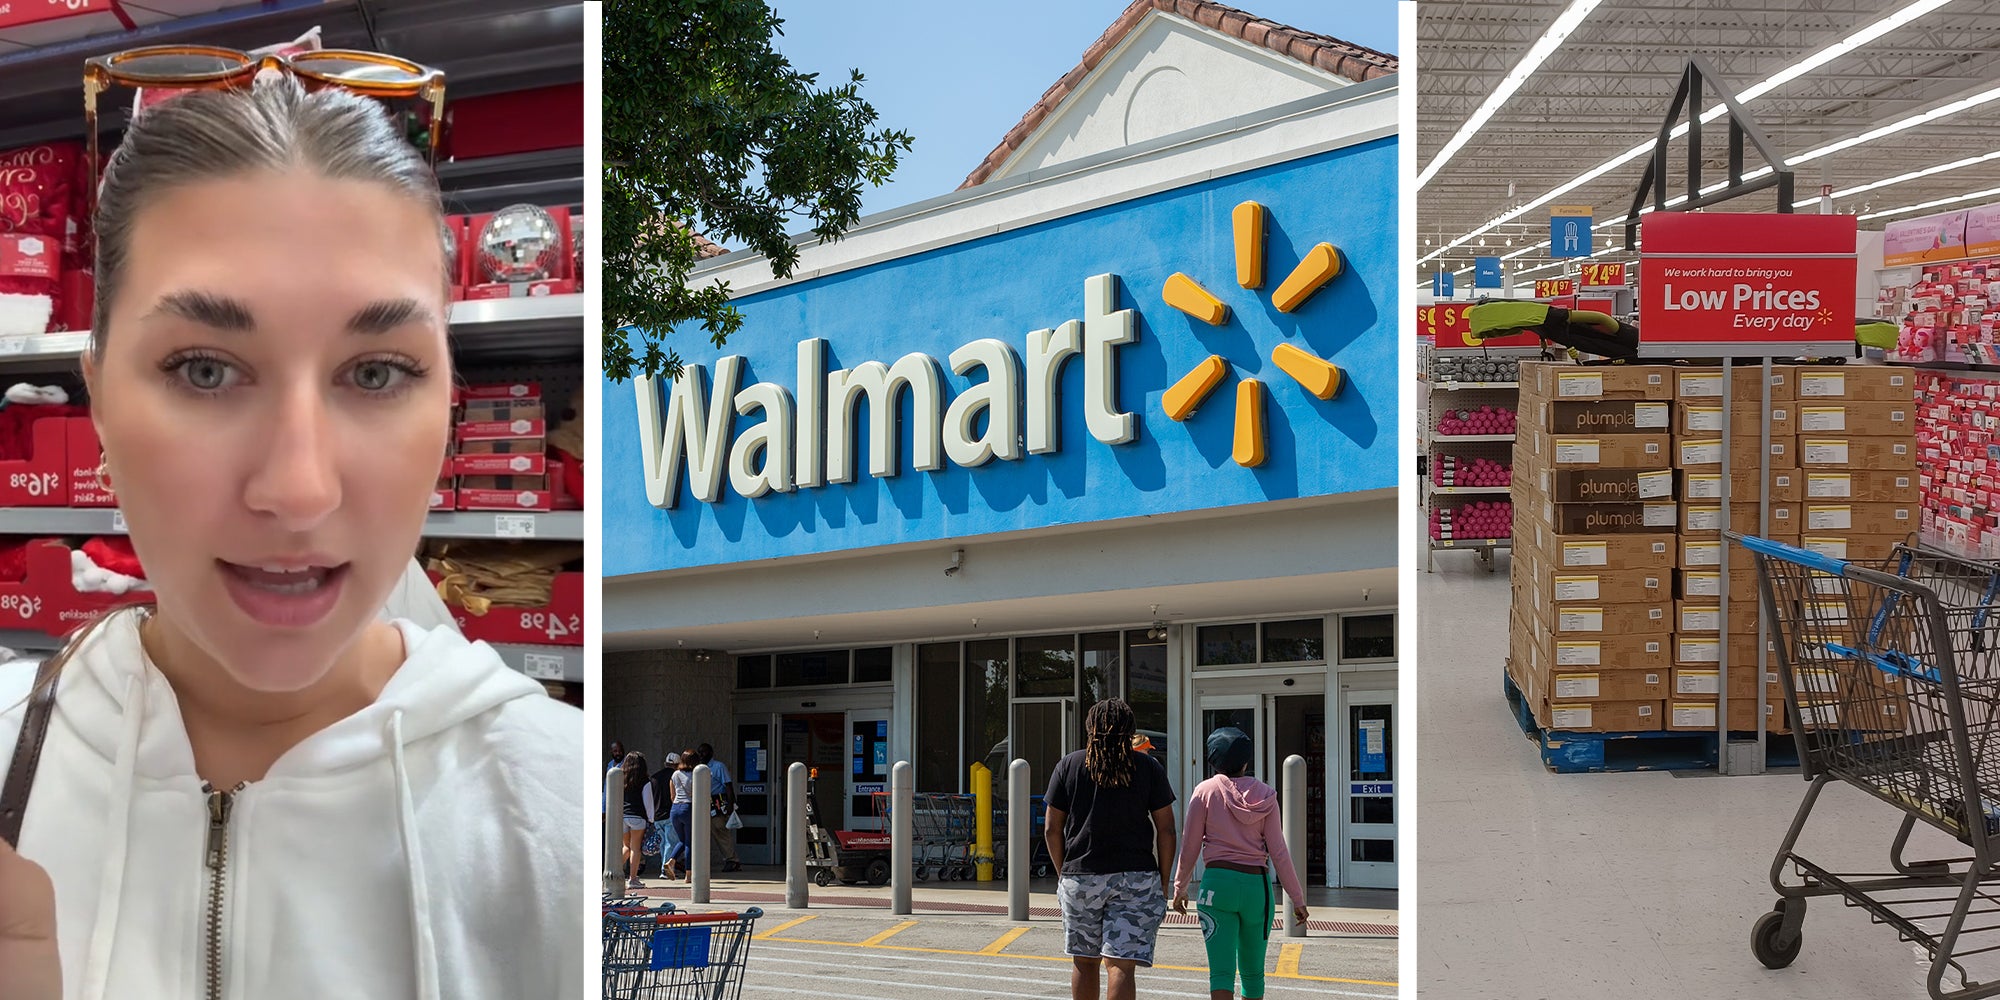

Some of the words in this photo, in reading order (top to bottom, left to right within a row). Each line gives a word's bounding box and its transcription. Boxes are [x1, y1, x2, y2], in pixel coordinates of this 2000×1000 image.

[1664, 268, 1680, 277] We
[1682, 268, 1706, 277] work
[1707, 268, 1732, 277] hard
[1733, 268, 1745, 277] to
[1746, 268, 1773, 278] bring
[1774, 269, 1793, 280] you
[1664, 283, 1727, 311] Low
[1733, 283, 1820, 311] Prices
[1733, 313, 1780, 331] Every
[1782, 313, 1815, 331] day
[634, 272, 1141, 509] Walmart
[742, 785, 763, 793] Entrance
[858, 785, 881, 793] Entrance
[1362, 784, 1381, 794] Exit
